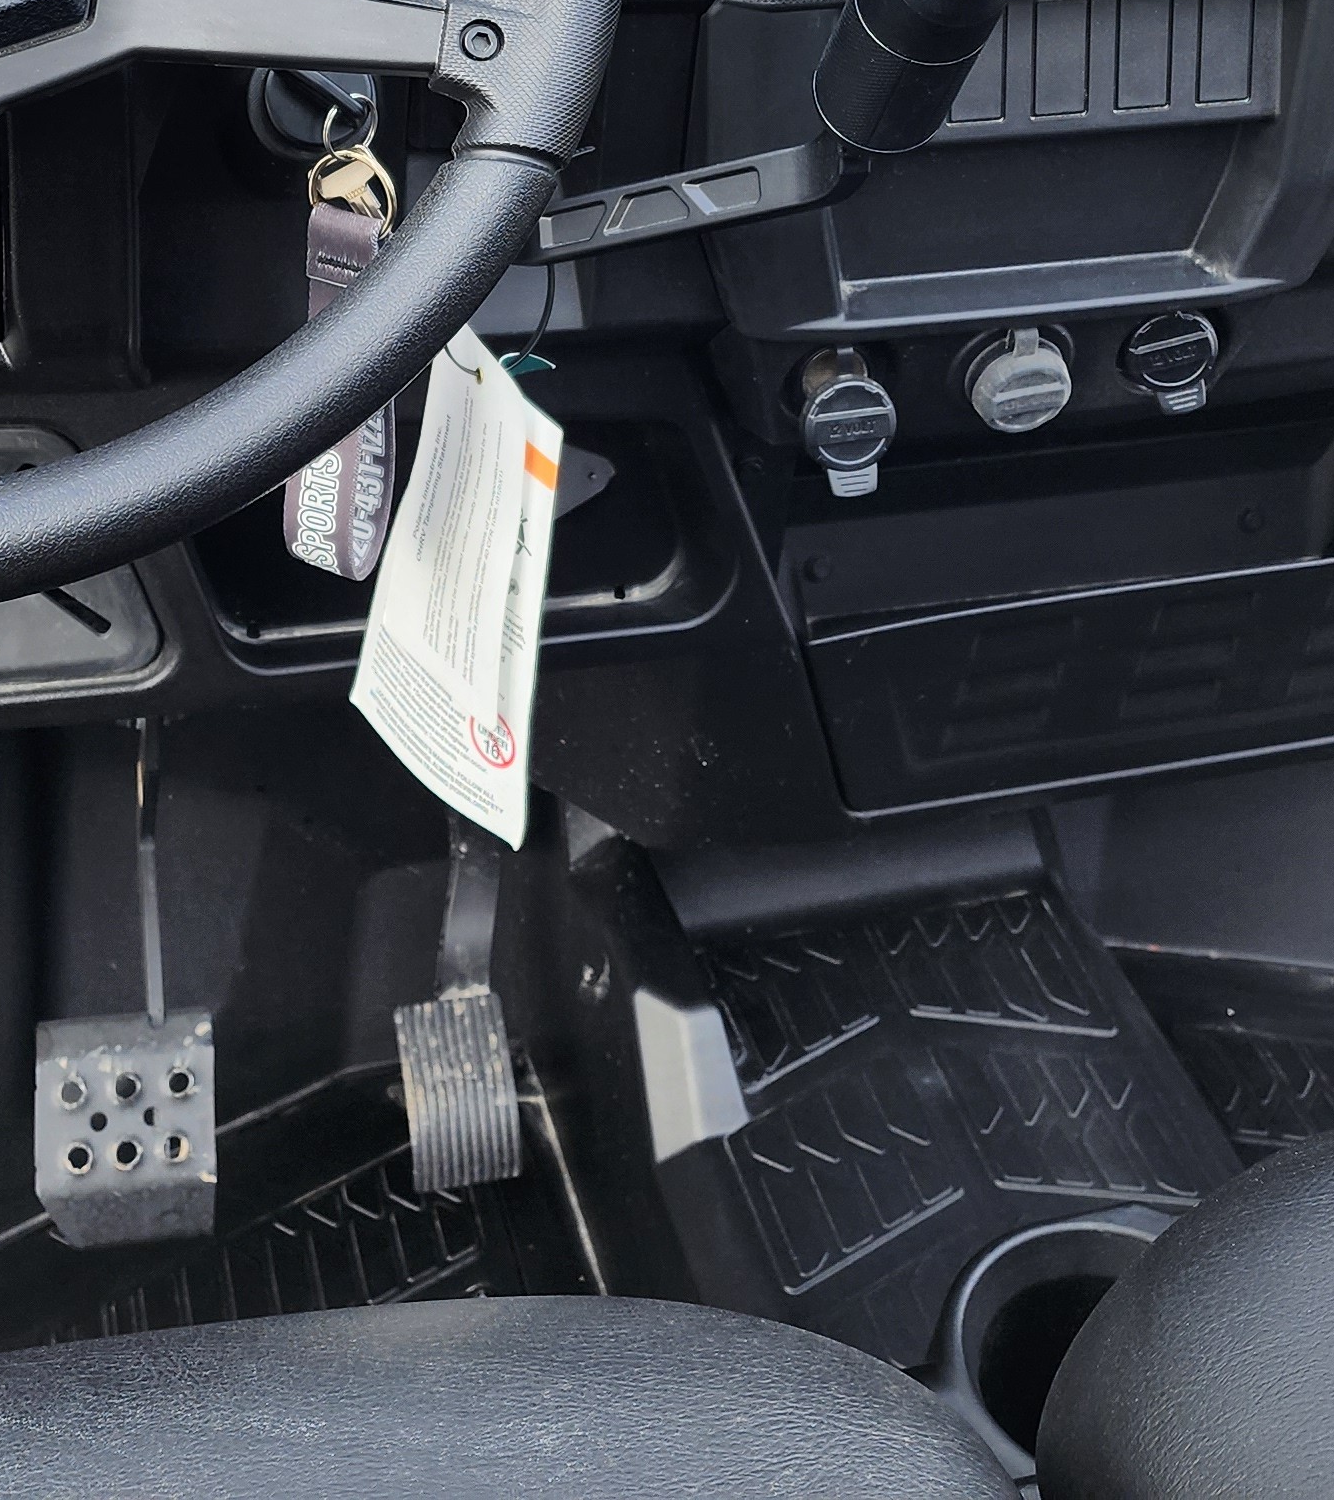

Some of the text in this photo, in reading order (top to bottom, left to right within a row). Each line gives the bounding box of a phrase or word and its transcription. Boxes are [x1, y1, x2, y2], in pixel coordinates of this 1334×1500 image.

[412, 501, 425, 538] Polaris
[422, 446, 439, 499] Industries
[423, 471, 442, 526] Tampering
[437, 414, 452, 468] Statement
